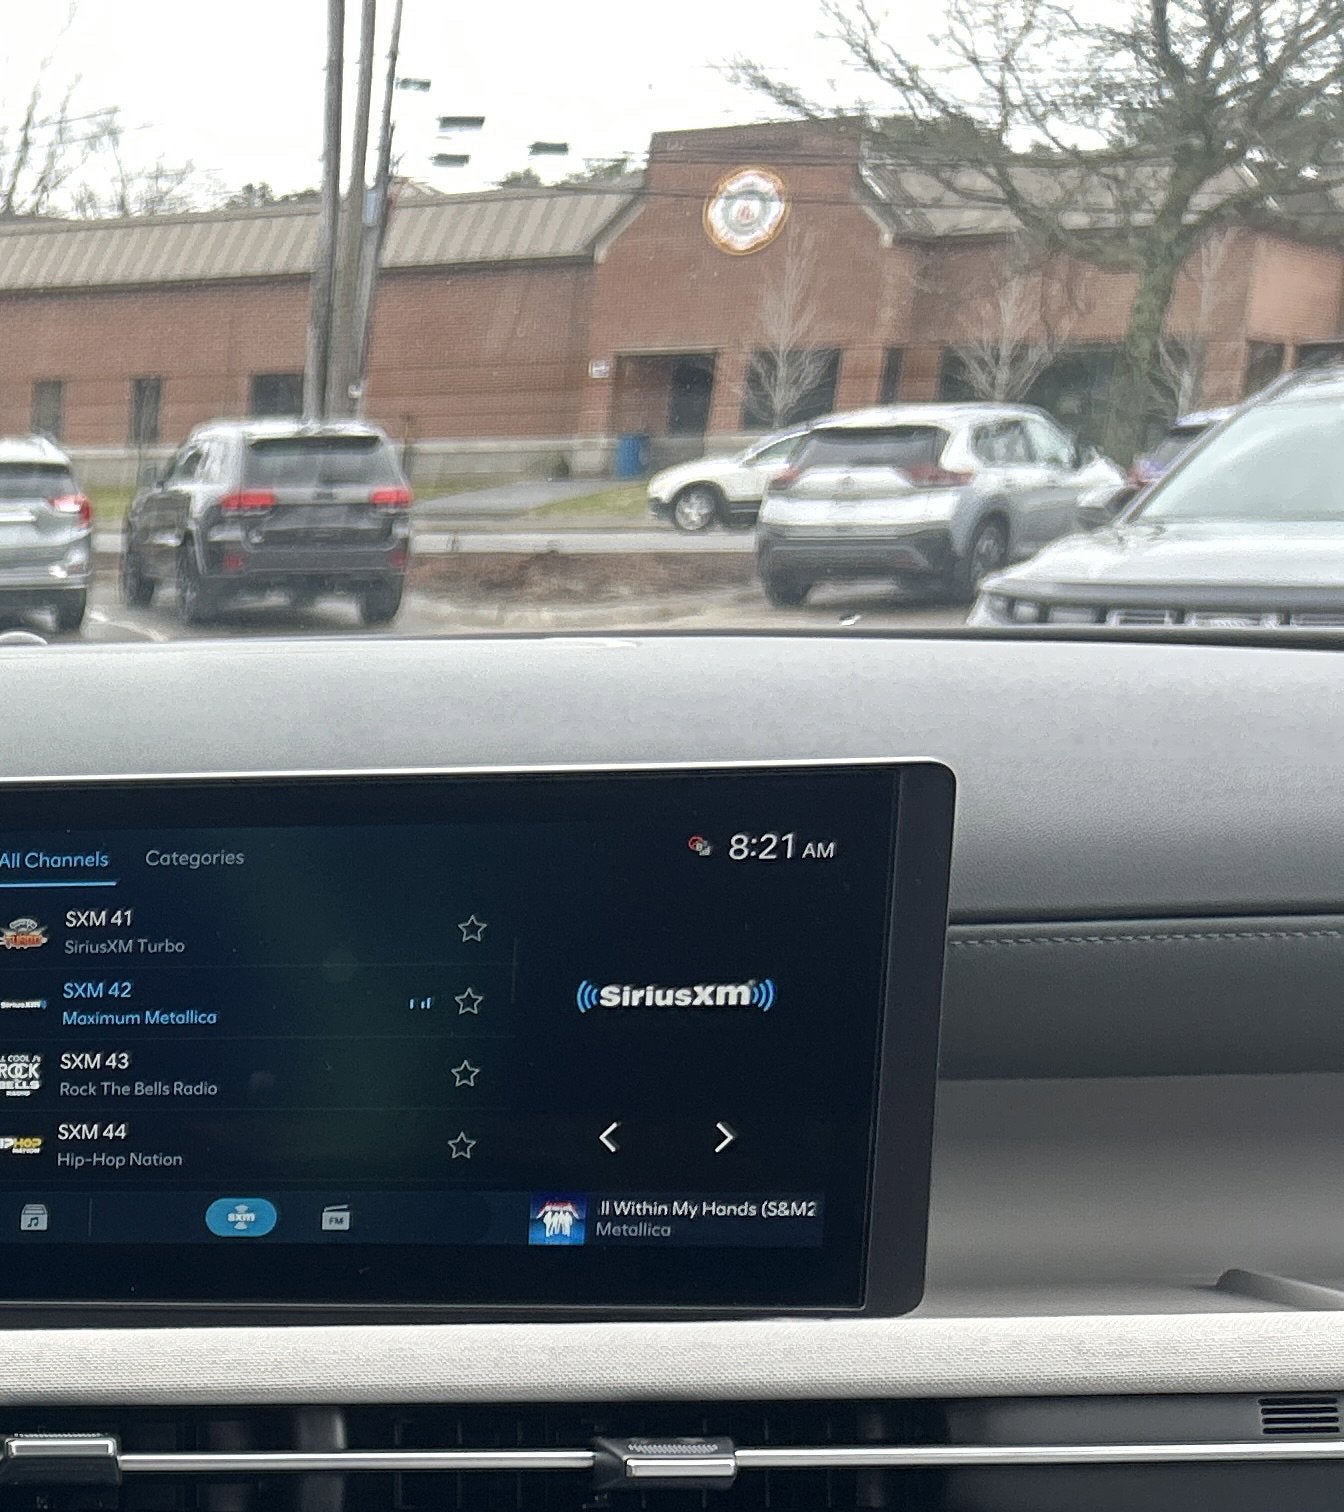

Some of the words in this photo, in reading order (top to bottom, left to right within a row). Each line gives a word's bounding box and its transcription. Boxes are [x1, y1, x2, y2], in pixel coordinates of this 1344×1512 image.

[729, 833, 795, 860] 8:21
[801, 841, 835, 858] AM
[25, 851, 108, 868] Channels
[146, 850, 244, 869] Categories
[66, 911, 106, 927] SXM
[111, 910, 131, 926] 41
[65, 939, 133, 954] SiriusXM
[137, 939, 185, 953] Turbo
[63, 983, 103, 998] SXM
[108, 982, 131, 997] 42
[63, 1012, 140, 1025] Maximum
[145, 1010, 217, 1024] Metallica
[61, 1054, 101, 1069] SXM
[106, 1053, 128, 1069] 43
[60, 1082, 96, 1095] Rock
[101, 1082, 130, 1095] The
[135, 1082, 169, 1095] Bells
[174, 1082, 217, 1095] Radio
[58, 1124, 98, 1140] SXM
[103, 1124, 126, 1139] 44
[58, 1153, 125, 1169] Hip-Hop
[130, 1153, 182, 1166] Nation
[614, 1200, 667, 1216] Within
[672, 1201, 698, 1218] My
[702, 1201, 757, 1216] Hands
[596, 1222, 671, 1237] Metallica
